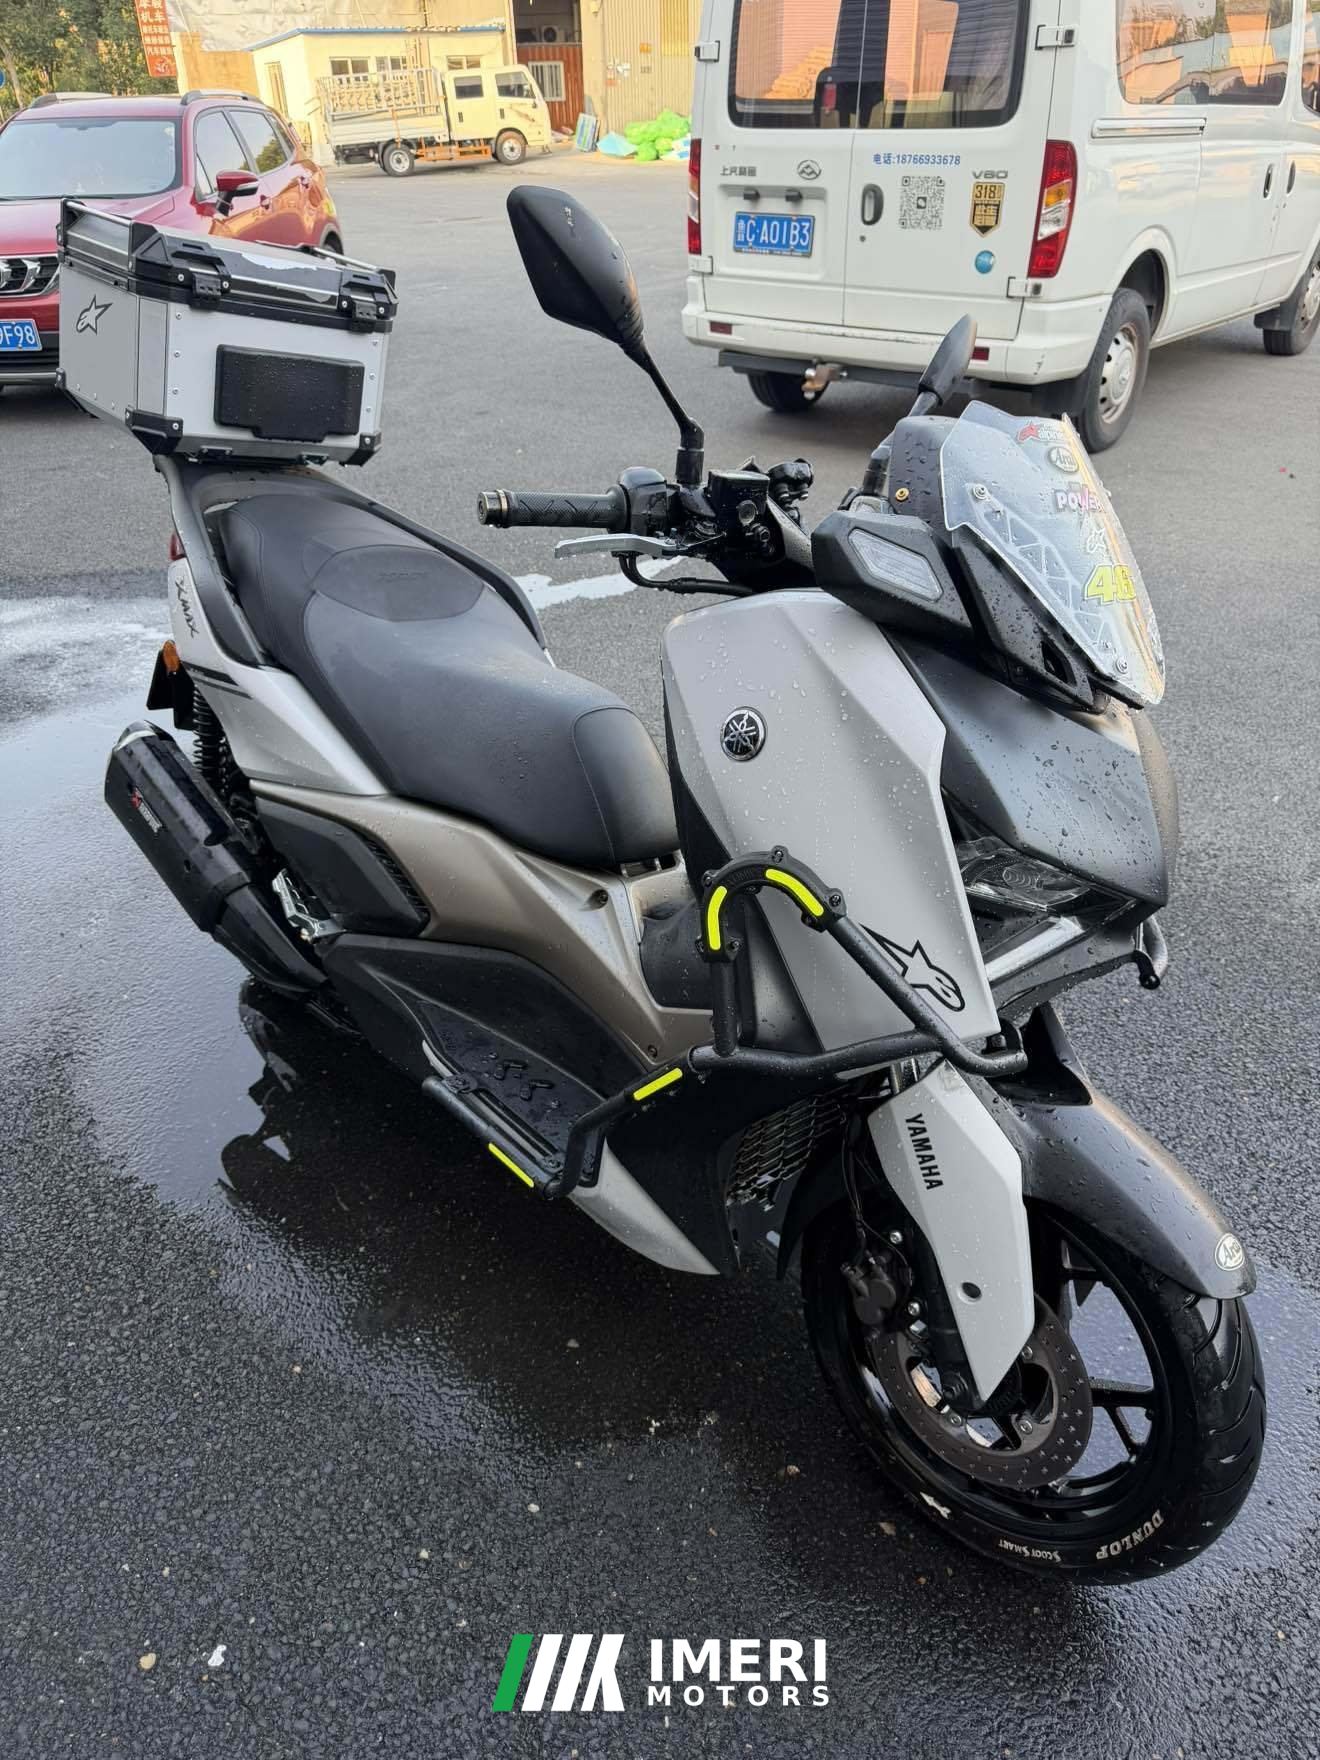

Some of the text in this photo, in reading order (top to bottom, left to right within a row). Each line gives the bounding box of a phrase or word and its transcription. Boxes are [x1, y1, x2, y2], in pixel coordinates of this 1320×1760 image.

[975, 184, 997, 199] 318
[1084, 564, 1137, 604] 46
[905, 1113, 944, 1190] YAMAHA
[1096, 1509, 1165, 1560] DUNLOP
